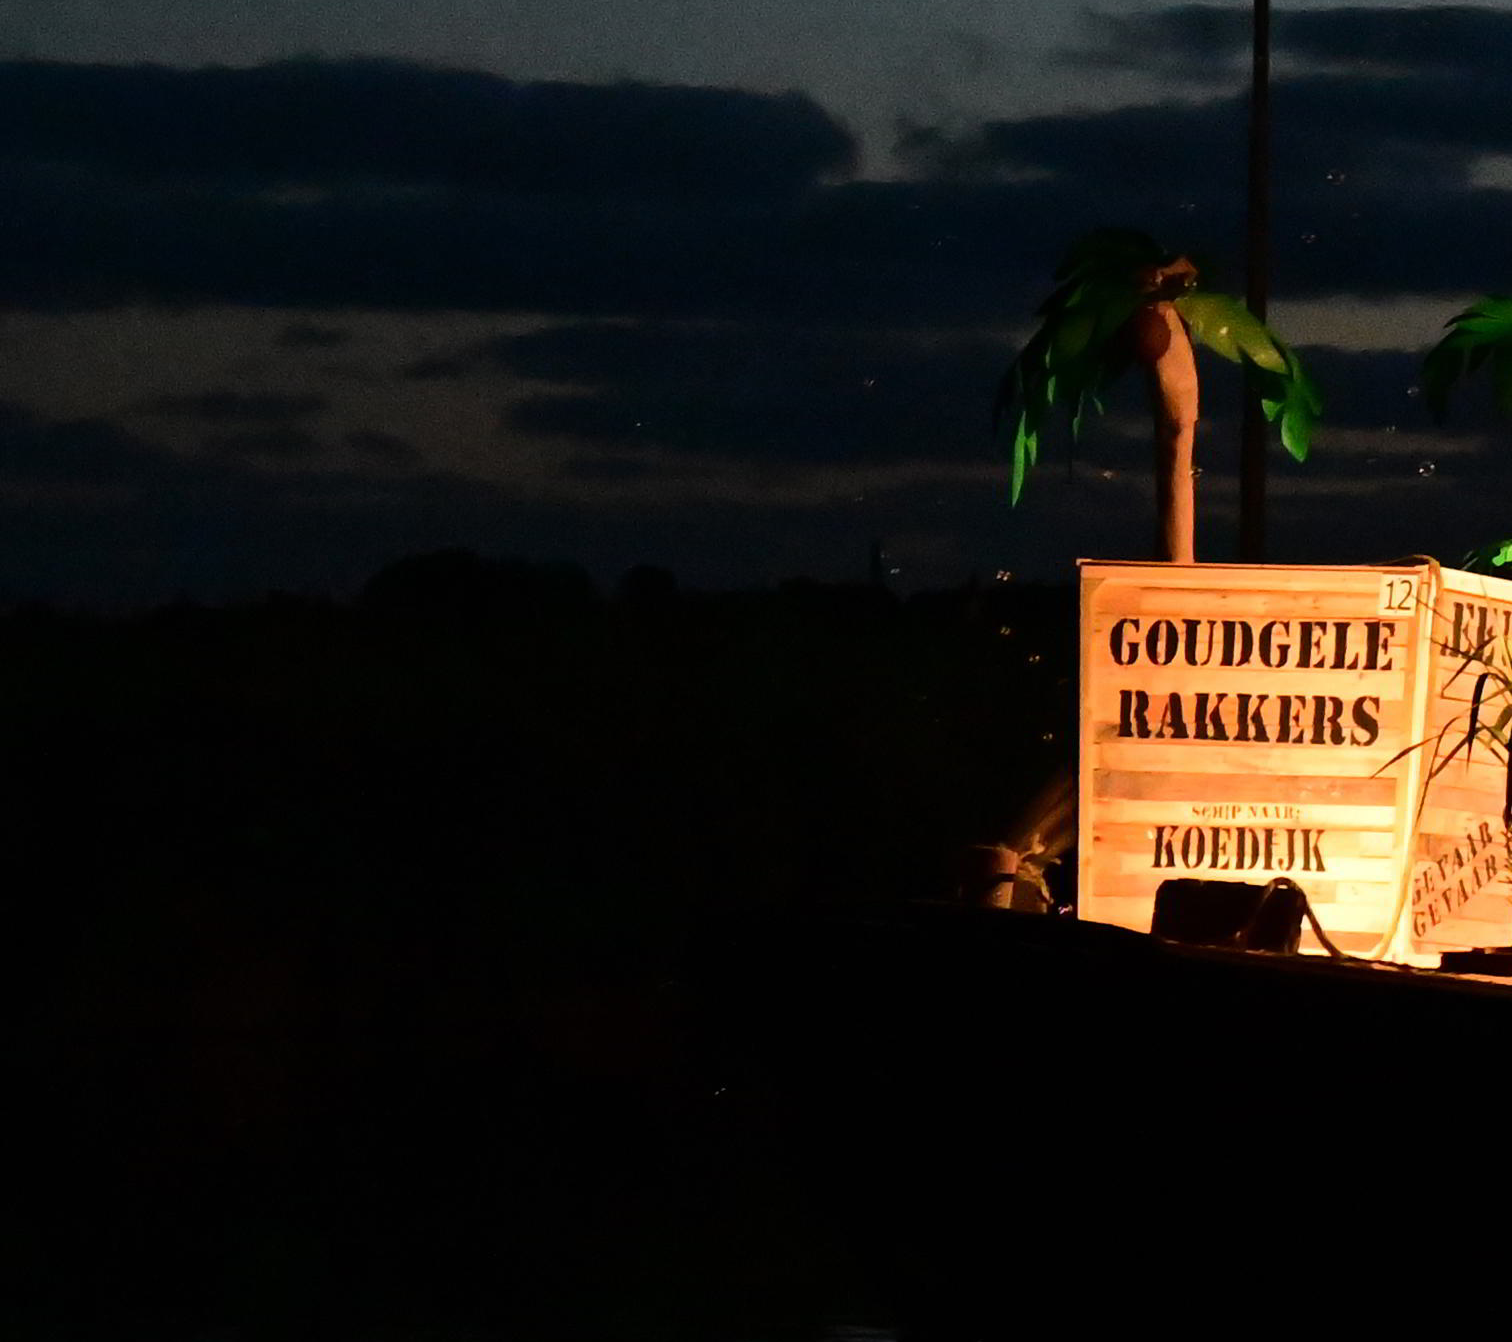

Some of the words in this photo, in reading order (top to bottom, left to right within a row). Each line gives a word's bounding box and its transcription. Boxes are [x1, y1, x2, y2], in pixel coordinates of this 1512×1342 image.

[1385, 579, 1413, 610] 12
[1109, 618, 1396, 670] GOUDGELE
[1117, 689, 1380, 746] RAKKERS
[1192, 805, 1241, 820] SCHIP
[1151, 825, 1326, 872] KOEDIJK
[1413, 854, 1497, 937] GEVAAR
